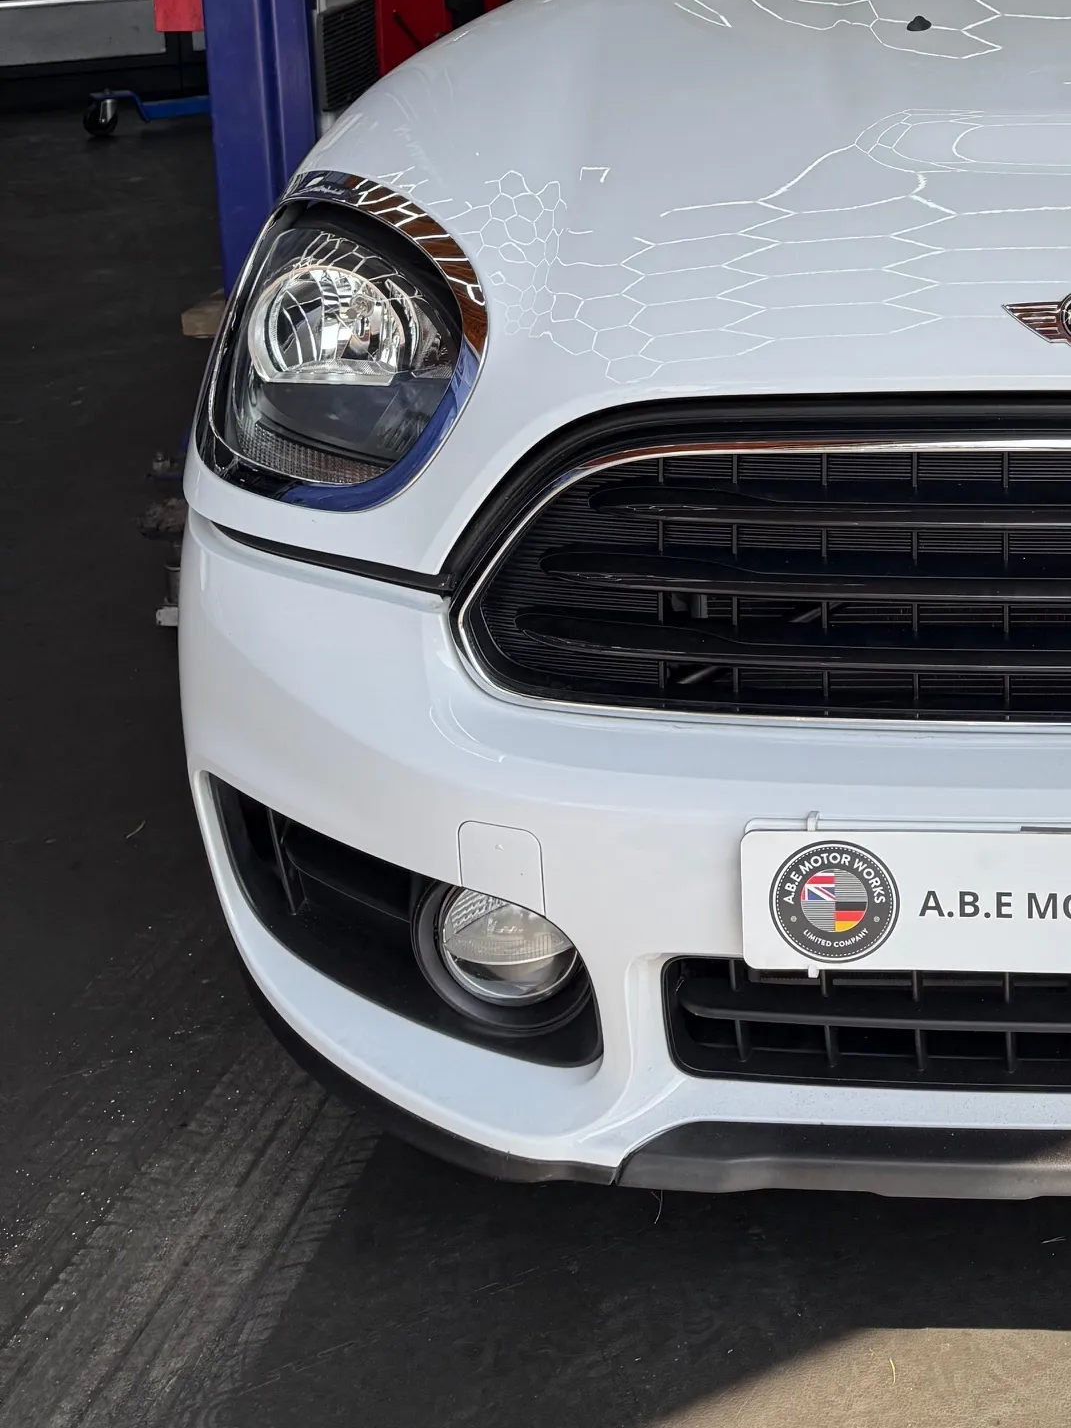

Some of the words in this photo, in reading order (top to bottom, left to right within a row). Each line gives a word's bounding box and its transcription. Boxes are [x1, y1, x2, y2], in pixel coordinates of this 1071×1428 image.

[783, 871, 803, 904] A.B.E
[799, 852, 851, 875] MOTOR
[853, 858, 886, 904] WORKS
[919, 890, 1013, 919] A.B.E
[803, 929, 832, 948] LIMITED
[833, 927, 869, 948] COMPANY
